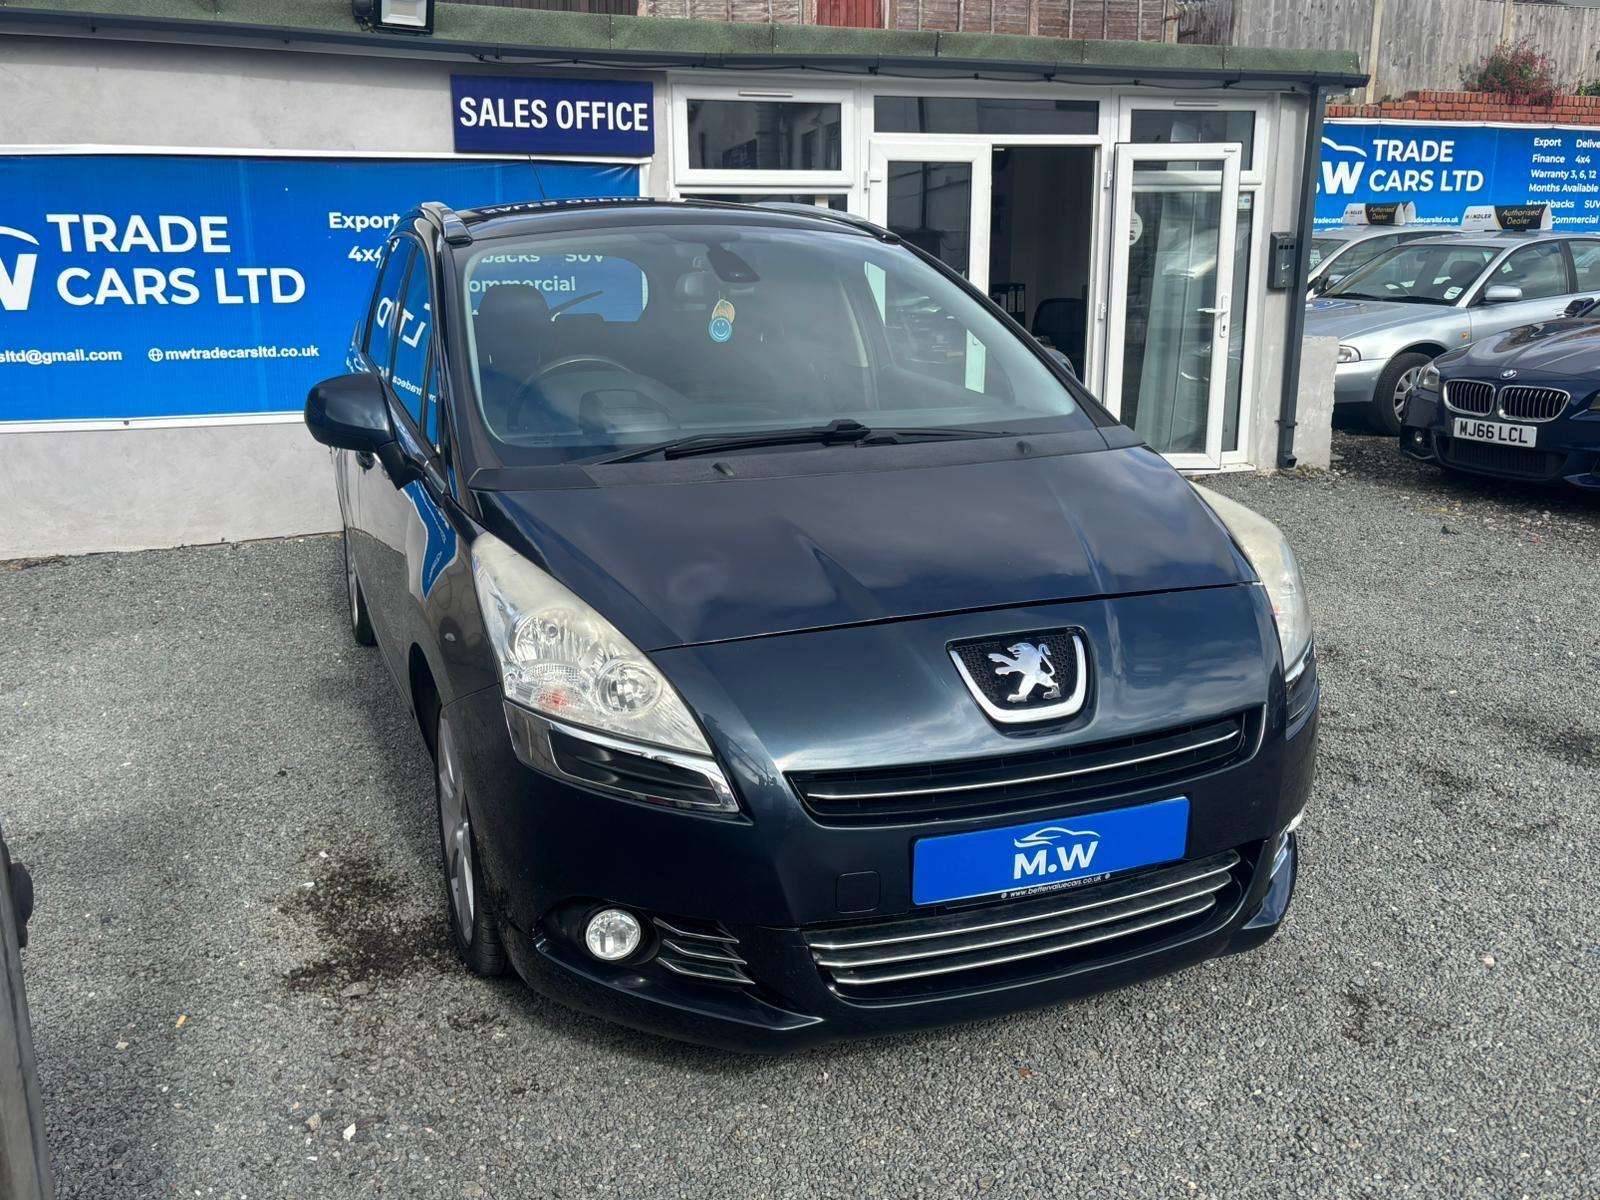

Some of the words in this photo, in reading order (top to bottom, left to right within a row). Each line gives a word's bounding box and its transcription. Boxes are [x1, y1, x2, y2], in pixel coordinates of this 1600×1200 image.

[460, 97, 548, 129] SALES
[556, 101, 649, 132] OFFICE
[1373, 139, 1455, 163] TRADE
[1534, 137, 1562, 149] Export
[1532, 154, 1565, 164] Finance
[1575, 155, 1591, 164] 4x4
[1369, 169, 1434, 193] CARS
[1440, 170, 1484, 193] LTD
[1530, 169, 1569, 180] Warranty
[1570, 170, 1577, 180] 3,
[1588, 170, 1597, 179] 12
[1528, 183, 1560, 193] Months
[1561, 184, 1599, 193] Available
[1502, 208, 1541, 217] Authorised
[1506, 216, 1531, 225] Dealer
[1551, 215, 1599, 224] Commercial
[329, 212, 400, 233] Export
[46, 213, 231, 253] TRADE
[57, 267, 201, 306] CARS
[215, 267, 306, 304] LTD
[165, 346, 319, 361] mwtradecarsltd.co.uk
[1459, 420, 1495, 439] MJ66
[1498, 424, 1528, 444] LCL
[1013, 841, 1098, 880] M.W
